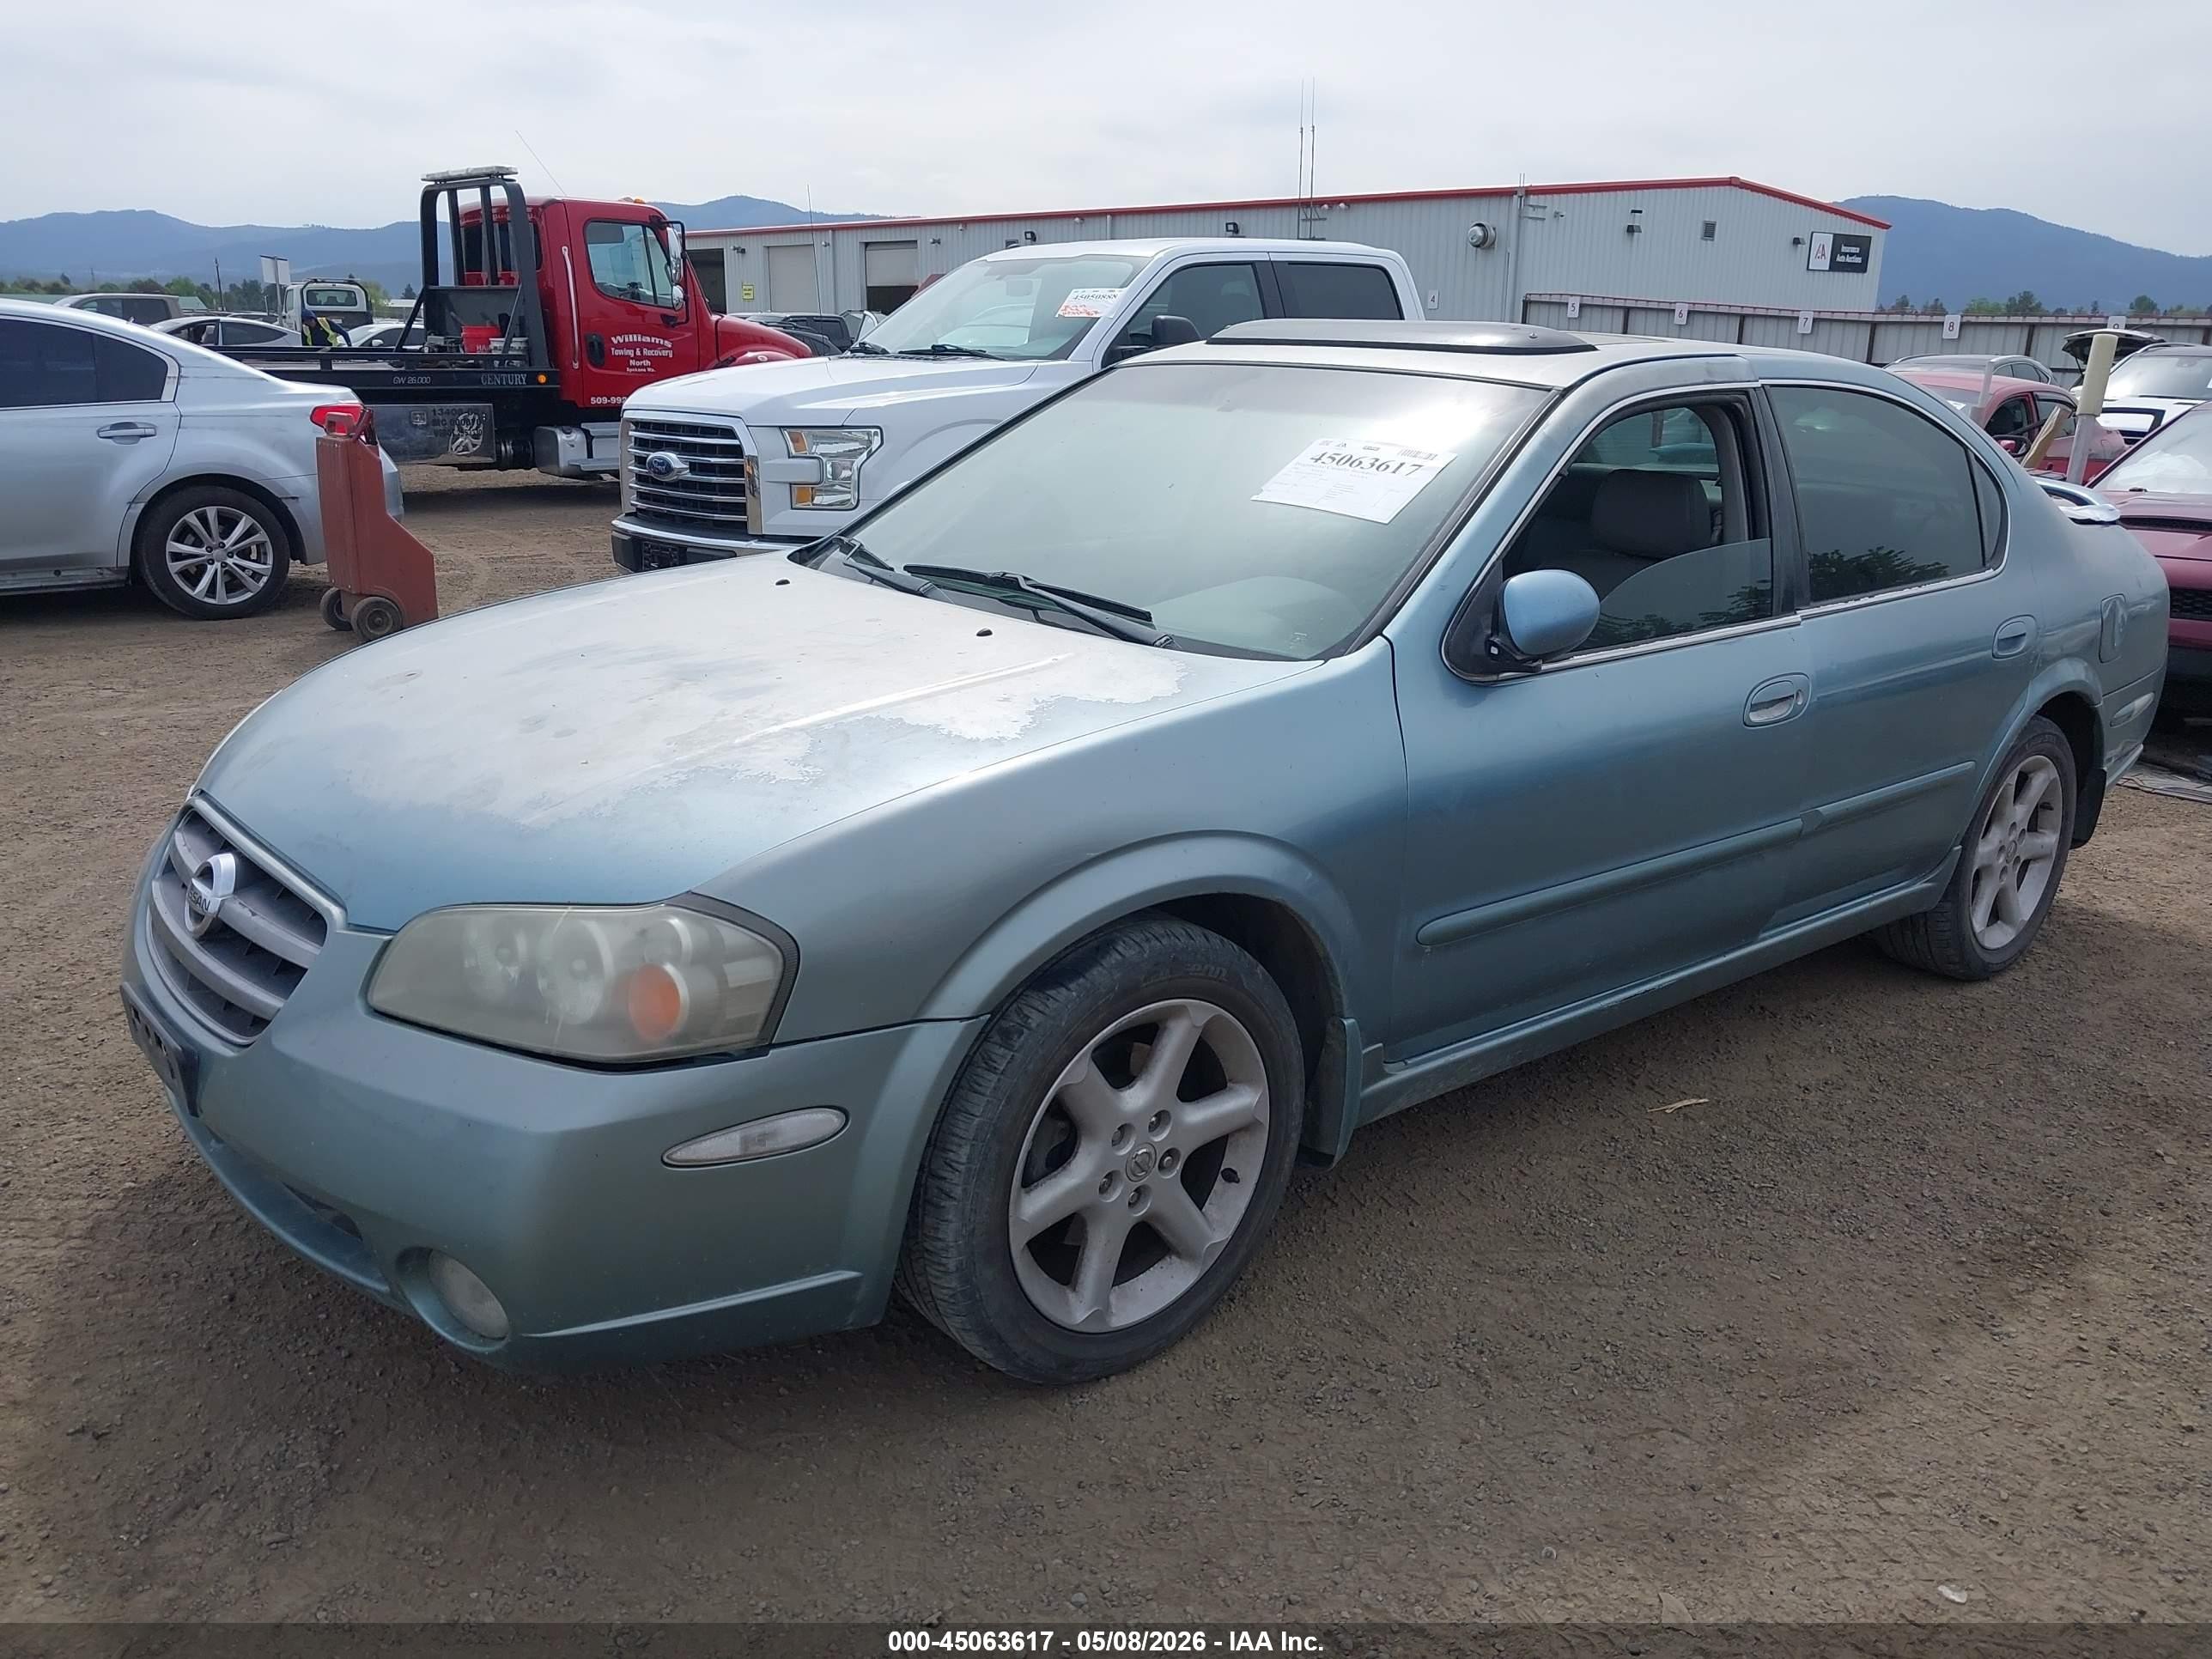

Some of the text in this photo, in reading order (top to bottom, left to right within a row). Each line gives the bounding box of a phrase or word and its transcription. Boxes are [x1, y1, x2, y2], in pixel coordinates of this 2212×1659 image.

[1430, 295, 1436, 303] 4
[1571, 302, 1576, 312] 5
[1678, 308, 1684, 319] 6
[1803, 317, 1808, 327] 7
[1948, 321, 1954, 331] 8
[611, 333, 673, 349] Williams
[611, 347, 673, 358] Towing & Recovery
[480, 373, 528, 386] CENTURY
[1310, 451, 1425, 477] 45063617
